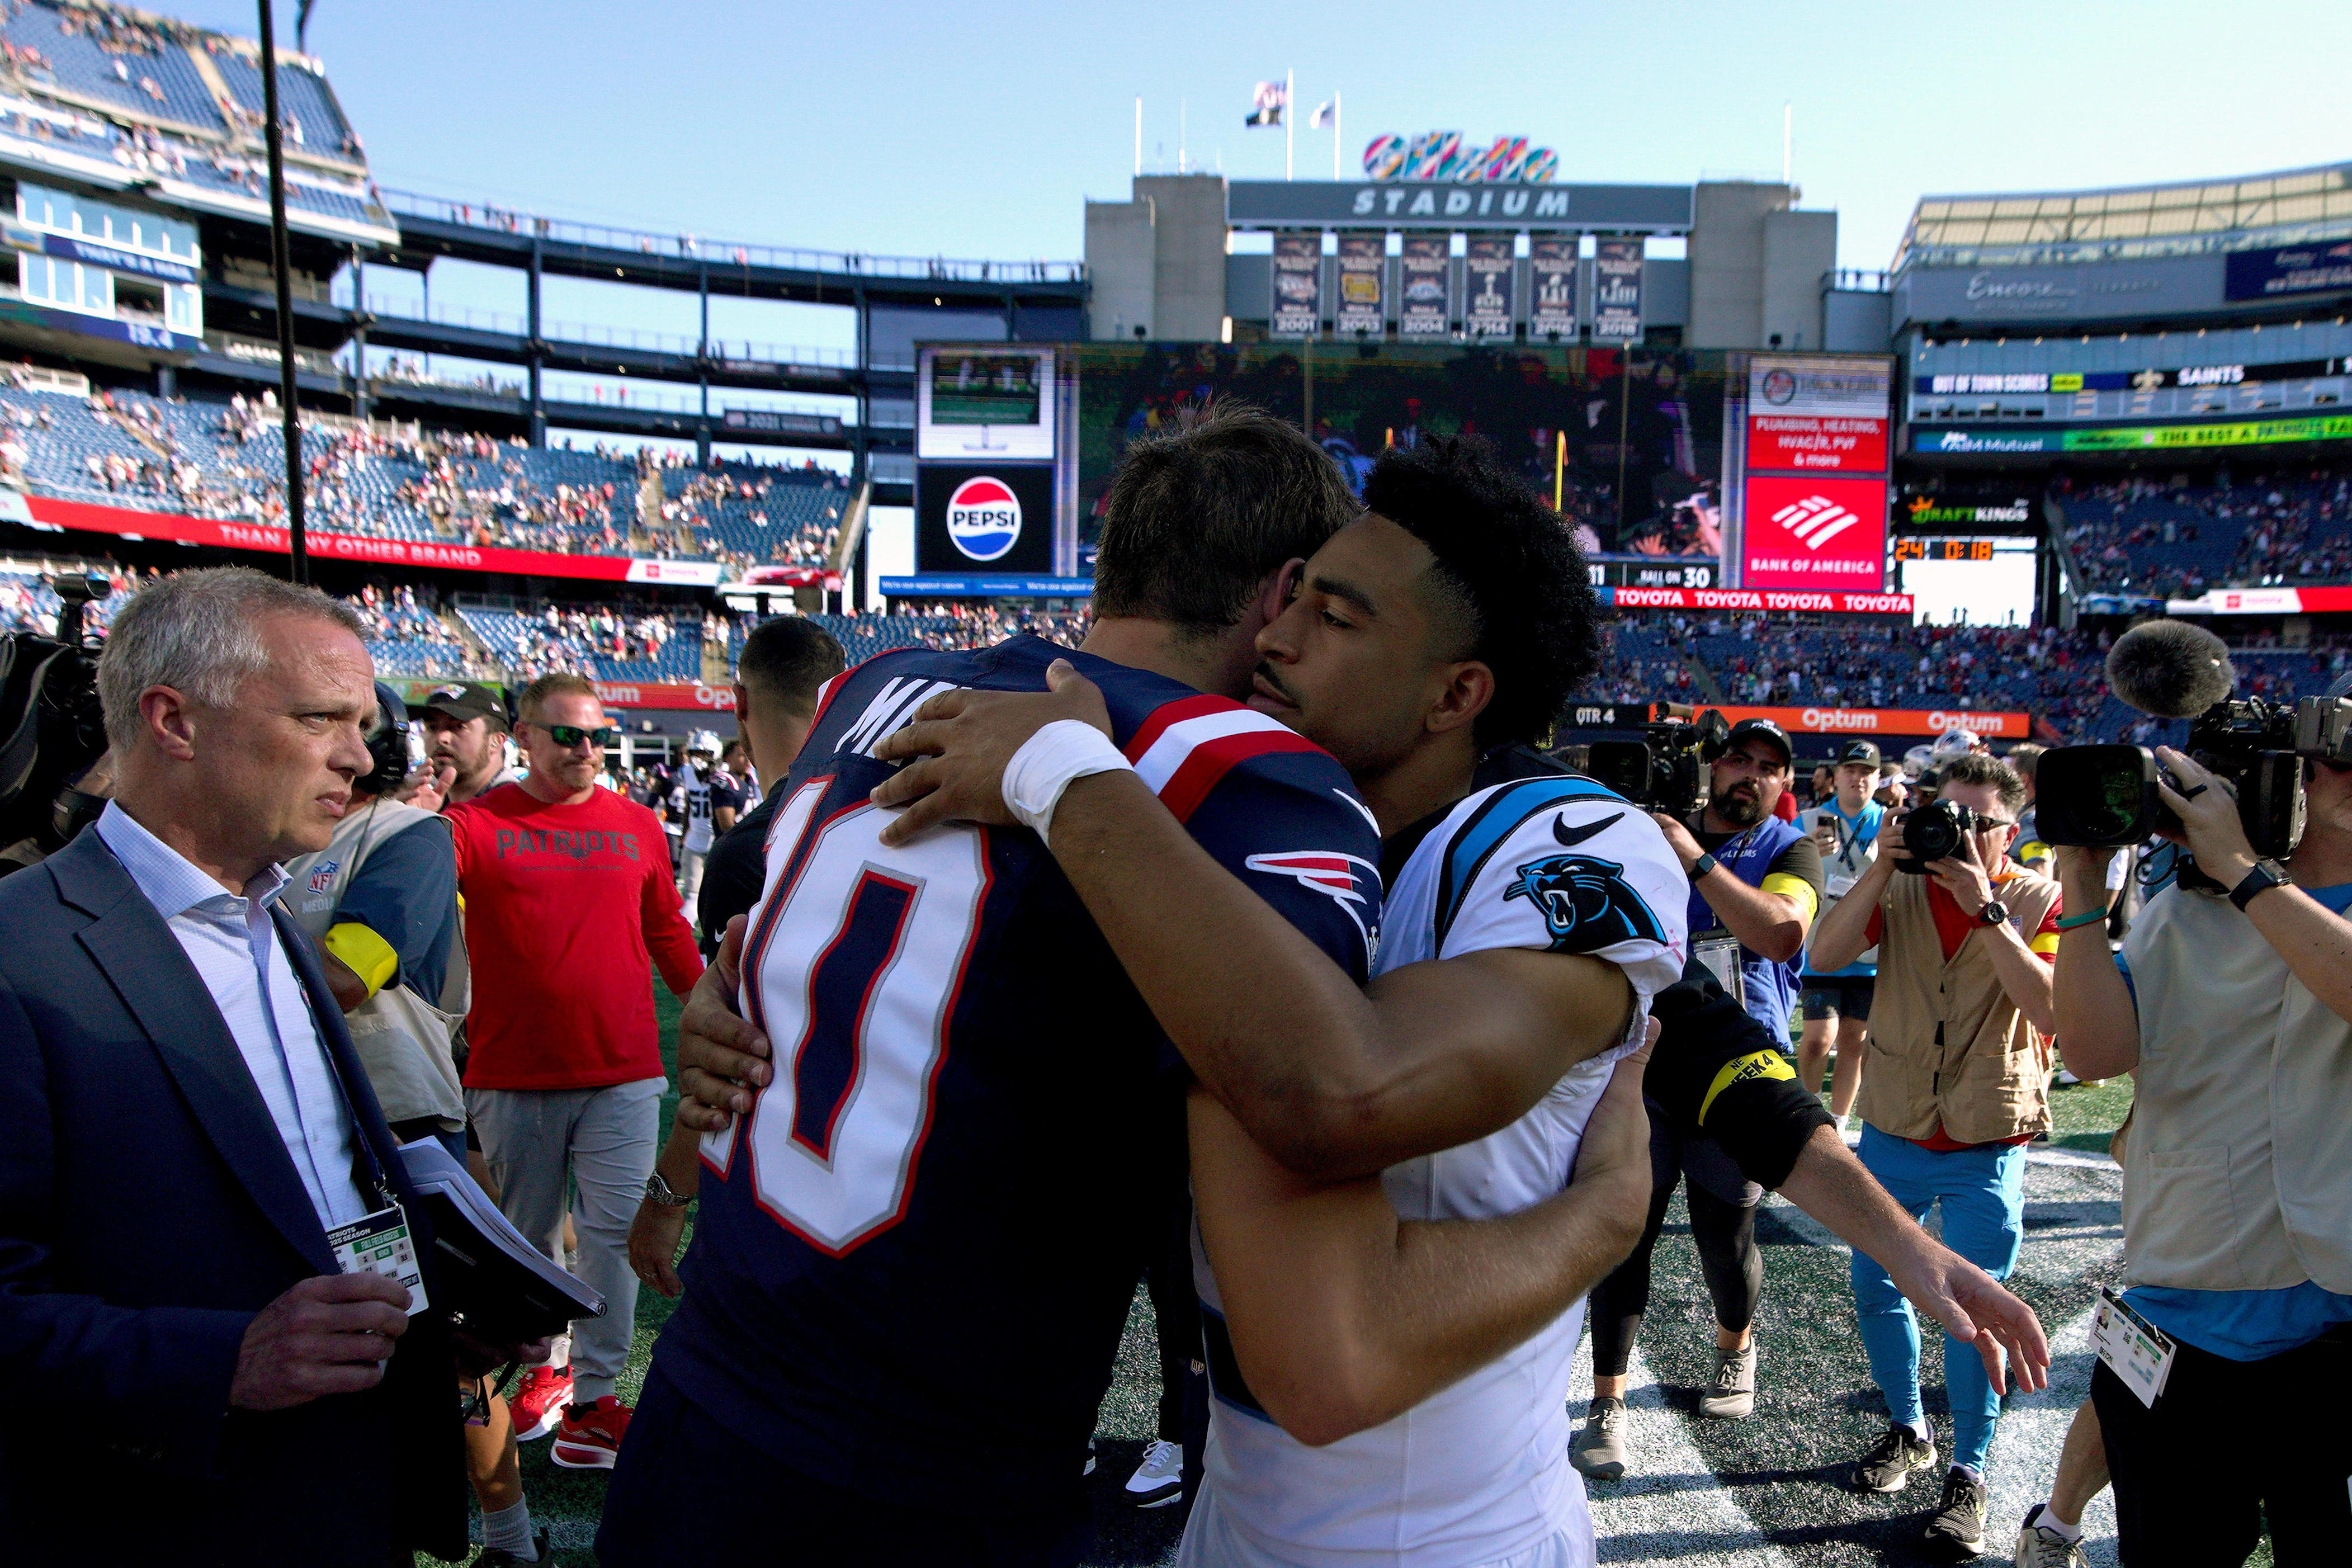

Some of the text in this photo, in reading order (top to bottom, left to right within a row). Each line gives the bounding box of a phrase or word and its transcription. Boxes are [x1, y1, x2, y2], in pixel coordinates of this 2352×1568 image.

[1363, 131, 1558, 184] Gillette
[1353, 188, 1569, 216] STADIUM
[2178, 365, 2245, 385] SAINTS
[1823, 421, 1880, 434] HEATING,
[1806, 455, 1841, 467] more
[953, 511, 1016, 526] PEPSI
[1911, 507, 2029, 524] DRAFTKINGS
[219, 525, 482, 566] THAN NY OTHER BRAND
[1751, 558, 1876, 574] BANK OF AMERICA
[1684, 566, 1711, 588] 30
[1616, 590, 1912, 612] TOYOTA TOYOTA TOYOTA TOYOTA
[594, 683, 640, 702] tum
[1576, 707, 1616, 725] QTR 4
[1802, 708, 1878, 732] Optum
[1928, 711, 2004, 732] Optum
[497, 829, 639, 861] PATRIOTS
[698, 774, 995, 1259] 10
[1730, 1057, 1745, 1070] NE
[1730, 1054, 1774, 1085] EEK 4
